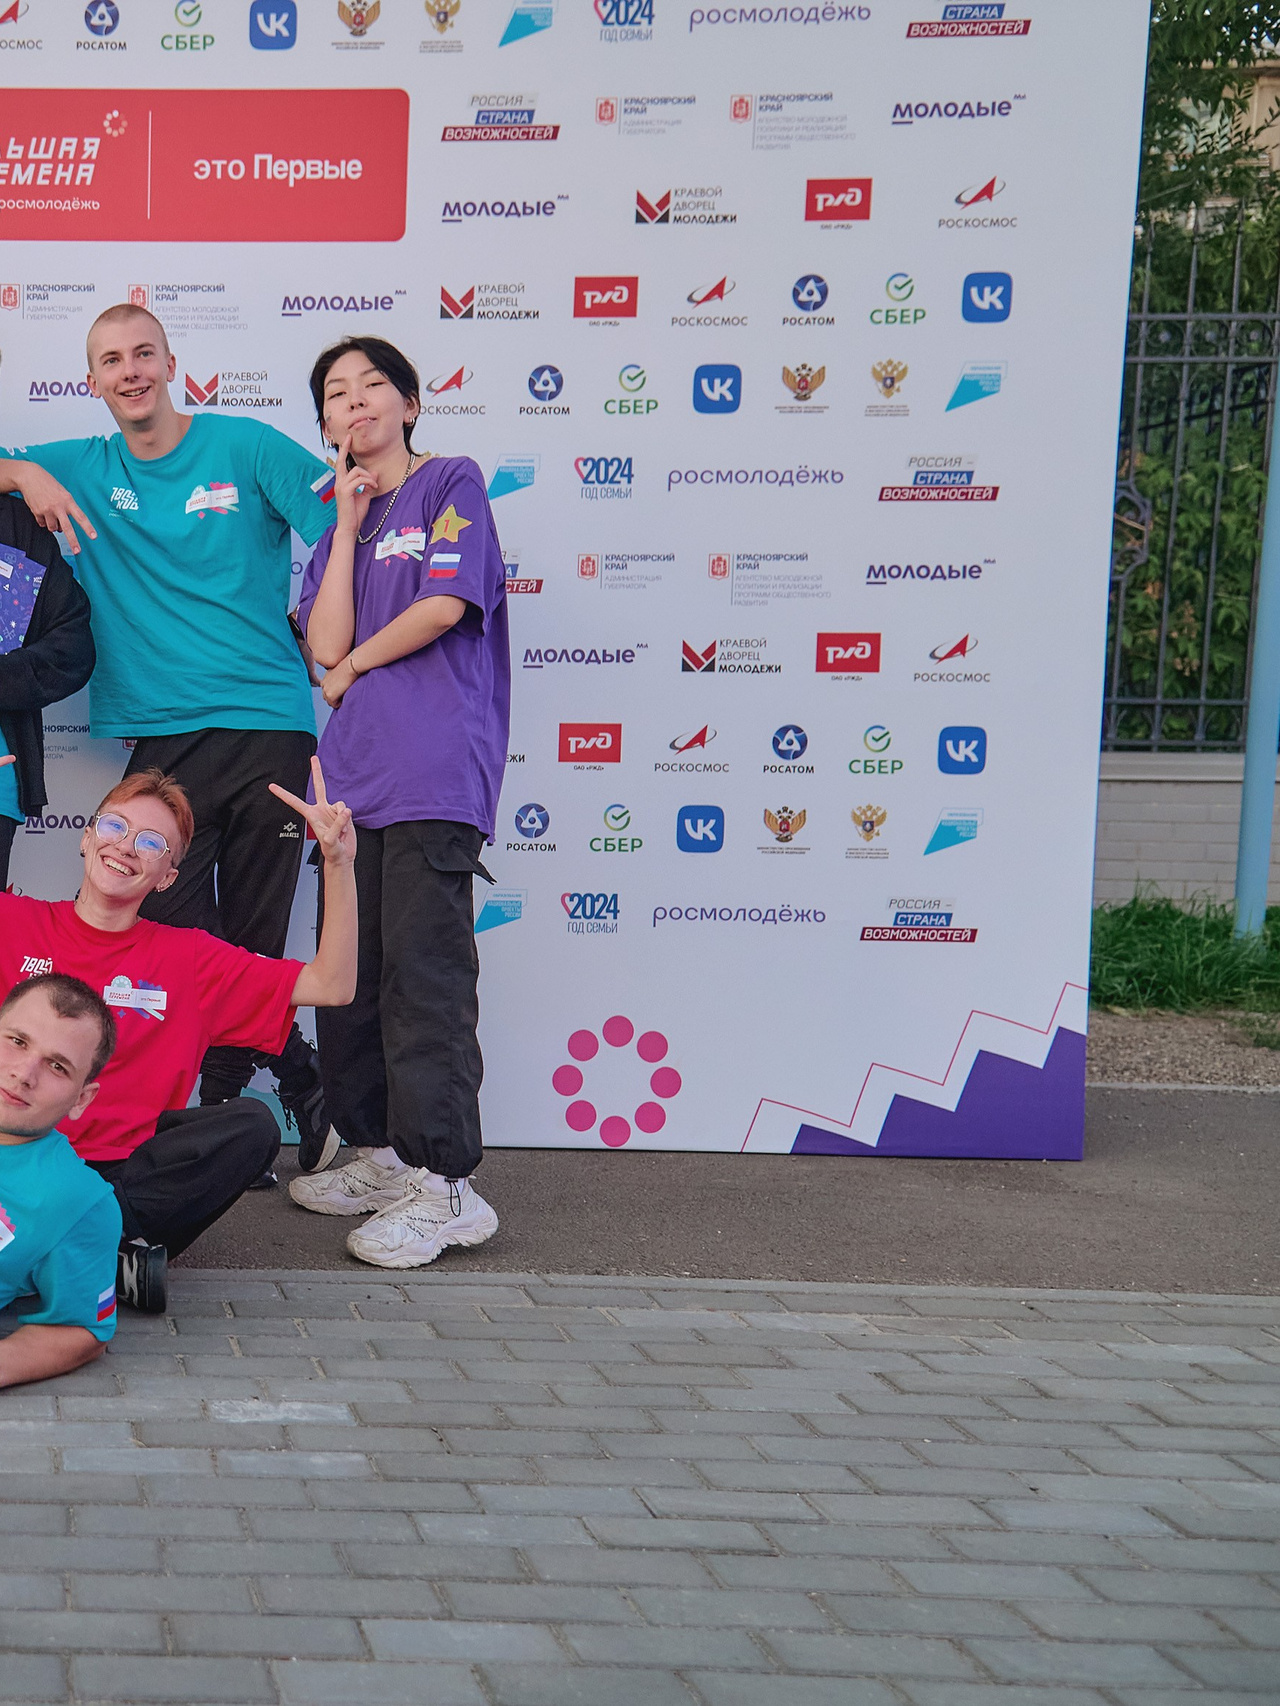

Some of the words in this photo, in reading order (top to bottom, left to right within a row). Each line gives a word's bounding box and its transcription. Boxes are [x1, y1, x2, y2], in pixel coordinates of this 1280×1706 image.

[602, 0, 655, 25] 2024
[689, 2, 871, 32] росмолодёжь
[946, 5, 1000, 19] СТРАНА
[256, 12, 290, 37] VK
[910, 20, 1026, 37] ВОЗМОЖНОСТЕЙ
[600, 29, 618, 42] ГОД
[77, 41, 126, 50] РОСАТОМ
[161, 35, 214, 50] СБЕР
[470, 95, 523, 107] РОССИЯ
[624, 96, 696, 105] КРАСНОЯРСКИЙ
[759, 92, 834, 103] КРАСНОЯРСКИЙ
[624, 106, 647, 115] КРАЙ
[759, 103, 783, 112] КРАЙ
[479, 111, 530, 124] СТРАНА
[444, 126, 554, 140] ВОЗМОЖНОСТЕЙ
[193, 159, 245, 180] это
[254, 153, 363, 188] Первые
[674, 188, 723, 197] КРАЕВОЙ
[673, 201, 715, 211] ДВОРЕЦ
[673, 215, 736, 224] МОЛОДЕЖИ
[938, 217, 1017, 228] РОСКОСМОС
[26, 284, 95, 293] КРАСНОЯРСКИЙ
[155, 284, 225, 294] КРАСНОЯРСКИЙ
[477, 283, 525, 294] КРАЕВОЙ
[26, 293, 49, 301] КРАЙ
[155, 293, 178, 301] КРАЙ
[477, 297, 518, 307] ДВОРЕЦ
[970, 285, 1005, 311] VK
[477, 311, 539, 320] МОЛОДЕЖИ
[783, 317, 834, 325] РОСАТОМ
[870, 309, 926, 324] СБЕР
[672, 317, 747, 326] РОСКОСМОС
[221, 371, 268, 382] КРАЕВОЙ
[221, 385, 261, 394] ДВОРЕЦ
[701, 378, 734, 401] VK
[221, 398, 282, 407] МОЛОДЕЖИ
[604, 399, 658, 414] СБЕР
[420, 405, 486, 415] ОСКОСМОС
[520, 407, 570, 415] РОСАТОМ
[909, 456, 962, 467] РОССИЯ
[583, 457, 634, 485] 2024
[668, 466, 844, 491] росмолодёжь
[916, 472, 968, 485] СТРАНА
[581, 487, 598, 500] ГОД
[882, 487, 994, 500] ВОЗМОЖНОСТЕЙ
[444, 519, 450, 532] 1
[605, 552, 675, 562] КРАСНОЯРСКИЙ
[736, 552, 808, 561] КРАСНОЯРСКИЙ
[605, 562, 628, 571] КРАЙ
[736, 562, 760, 571] КРАЙ
[719, 638, 767, 648] КРАЕВОЙ
[719, 651, 760, 661] ДВОРЕЦ
[719, 664, 781, 673] МОЛОДЕЖИ
[914, 673, 990, 682] РОСКОСМОС
[945, 740, 978, 762] VK
[655, 763, 729, 772] РОСКОСМОС
[763, 765, 814, 773] РОСАТОМ
[849, 760, 903, 774] СБЕР
[684, 818, 717, 841] VK
[507, 843, 556, 851] РОСАТОМ
[590, 838, 642, 852] СБЕР
[570, 893, 620, 920] 2024
[889, 899, 941, 910] РОССИЯ
[653, 905, 826, 927] росмолодёжь
[896, 914, 947, 926] СТРАНА
[567, 922, 585, 935] ГОД
[864, 928, 972, 942] ВОЗМОЖНОСТЕЙ
